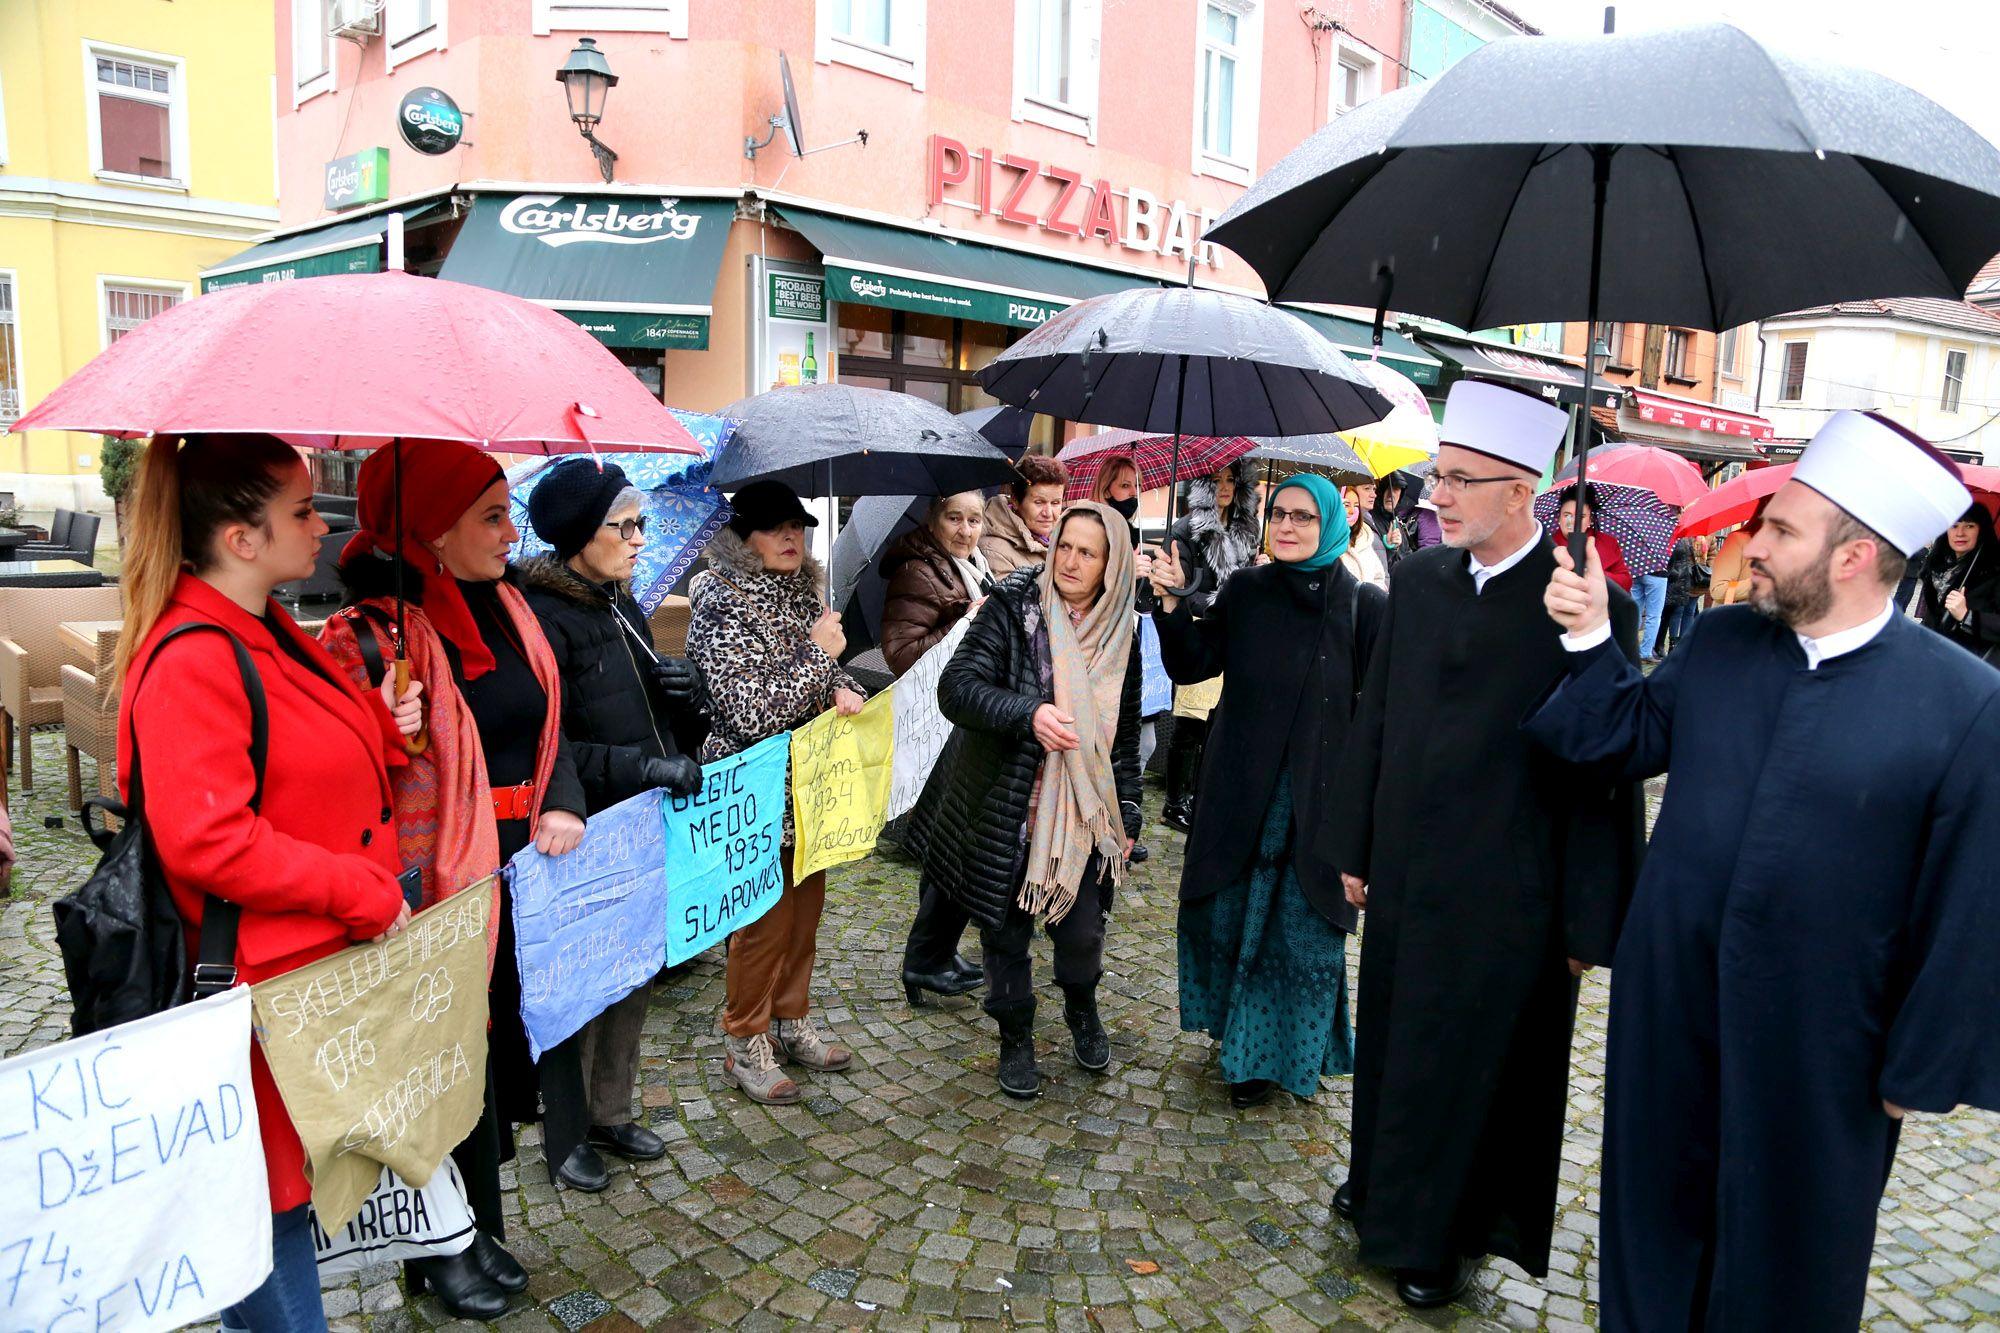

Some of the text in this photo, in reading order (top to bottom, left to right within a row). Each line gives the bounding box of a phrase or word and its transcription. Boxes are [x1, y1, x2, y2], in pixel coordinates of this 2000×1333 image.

[404, 104, 459, 135] Carlsberg
[328, 167, 359, 200] Carlsberg
[500, 195, 701, 247] Carlsberg
[775, 280, 821, 293] PROBABLY
[780, 289, 800, 300] BEST
[800, 292, 821, 303] BEER
[850, 275, 886, 297] Carlsberg
[889, 288, 912, 298] Probably
[775, 298, 821, 310] IN THE WORLD
[1008, 303, 1046, 323] PIZZA
[646, 328, 667, 338] 1847
[689, 793, 757, 854] MEDO
[725, 822, 773, 875] 1935
[315, 1017, 377, 1092] 1976
